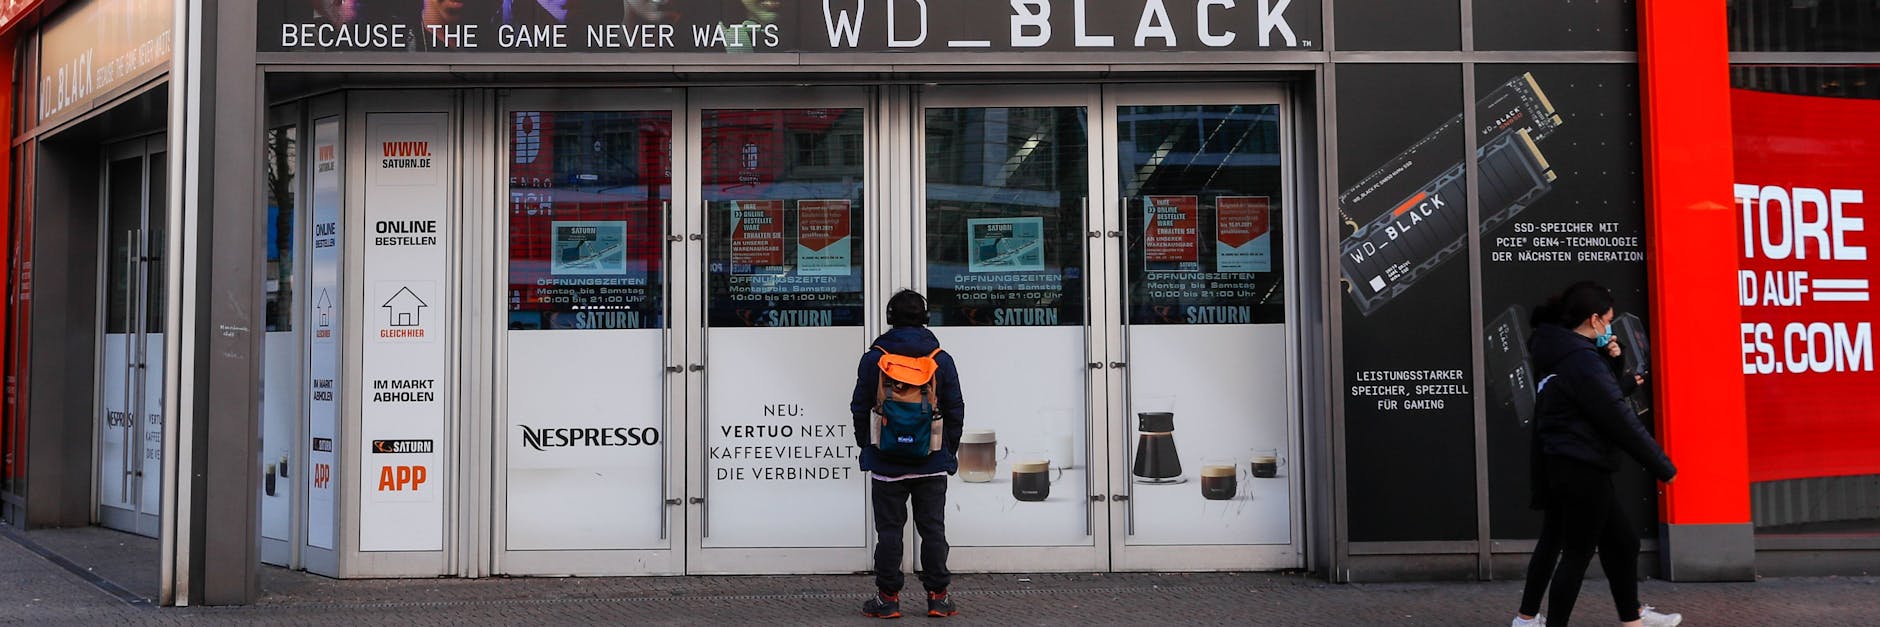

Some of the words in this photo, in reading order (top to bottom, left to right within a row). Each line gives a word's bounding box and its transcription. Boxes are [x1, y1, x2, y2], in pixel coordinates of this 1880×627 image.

[282, 23, 406, 48] BECAUSE
[427, 23, 478, 48] THE
[498, 23, 567, 48] GAME
[587, 23, 674, 48] NEVER
[692, 23, 780, 48] WAITS
[382, 159, 431, 168] SATURN.DE
[375, 220, 436, 234] ONLINE
[1350, 194, 1445, 264] WD_BLACK
[1514, 222, 1593, 233] SSD-SPEICHER
[1599, 222, 1619, 232] MIT
[375, 236, 436, 246] BESTELLEN
[1533, 236, 1638, 247] GEN4-TECHNOLOGIE
[1492, 251, 1512, 262] DER
[1518, 250, 1571, 262] NÄCHSTEN
[1577, 251, 1643, 262] GENERATION
[537, 277, 645, 285] ÖFFNUNGSZEITEN
[954, 274, 1062, 282] ÖFFNUNGSZEITEN
[1147, 272, 1255, 280] ÖFFNUNGSZEITEN
[580, 287, 595, 295] bis
[600, 287, 645, 295] Samstag
[793, 285, 837, 293] Samstag
[1763, 270, 1809, 306] AUF
[765, 293, 779, 301] bis
[990, 292, 1005, 300] bis
[576, 311, 639, 329] SATURN
[769, 310, 832, 327] SATURN
[994, 308, 1058, 325] SATURN
[1186, 306, 1250, 324] SATURN
[380, 329, 406, 338] GLEICH
[407, 329, 424, 338] HIER
[1740, 322, 1874, 374] ES.COM
[1356, 370, 1463, 381] LEISTUNGSSTARKER
[373, 379, 388, 389] IM
[391, 379, 435, 389] MARKT
[1351, 385, 1410, 396] SPEICHER,
[1415, 384, 1468, 395] SPEZIELL
[373, 392, 434, 402] ABHOLEN
[764, 404, 804, 417] NEU:
[1377, 399, 1398, 410] FÜR
[1404, 399, 1444, 410] GAMING
[721, 425, 793, 438] VERTUO
[801, 424, 847, 437] NEXT
[516, 424, 660, 451] NESPRESSO
[393, 441, 432, 453] SATURN
[710, 445, 858, 461] KAFFEEVIELFALT,
[314, 463, 330, 489] APP
[378, 466, 427, 491] APP
[717, 467, 745, 480] DIE
[752, 466, 851, 480] VERBINDET
